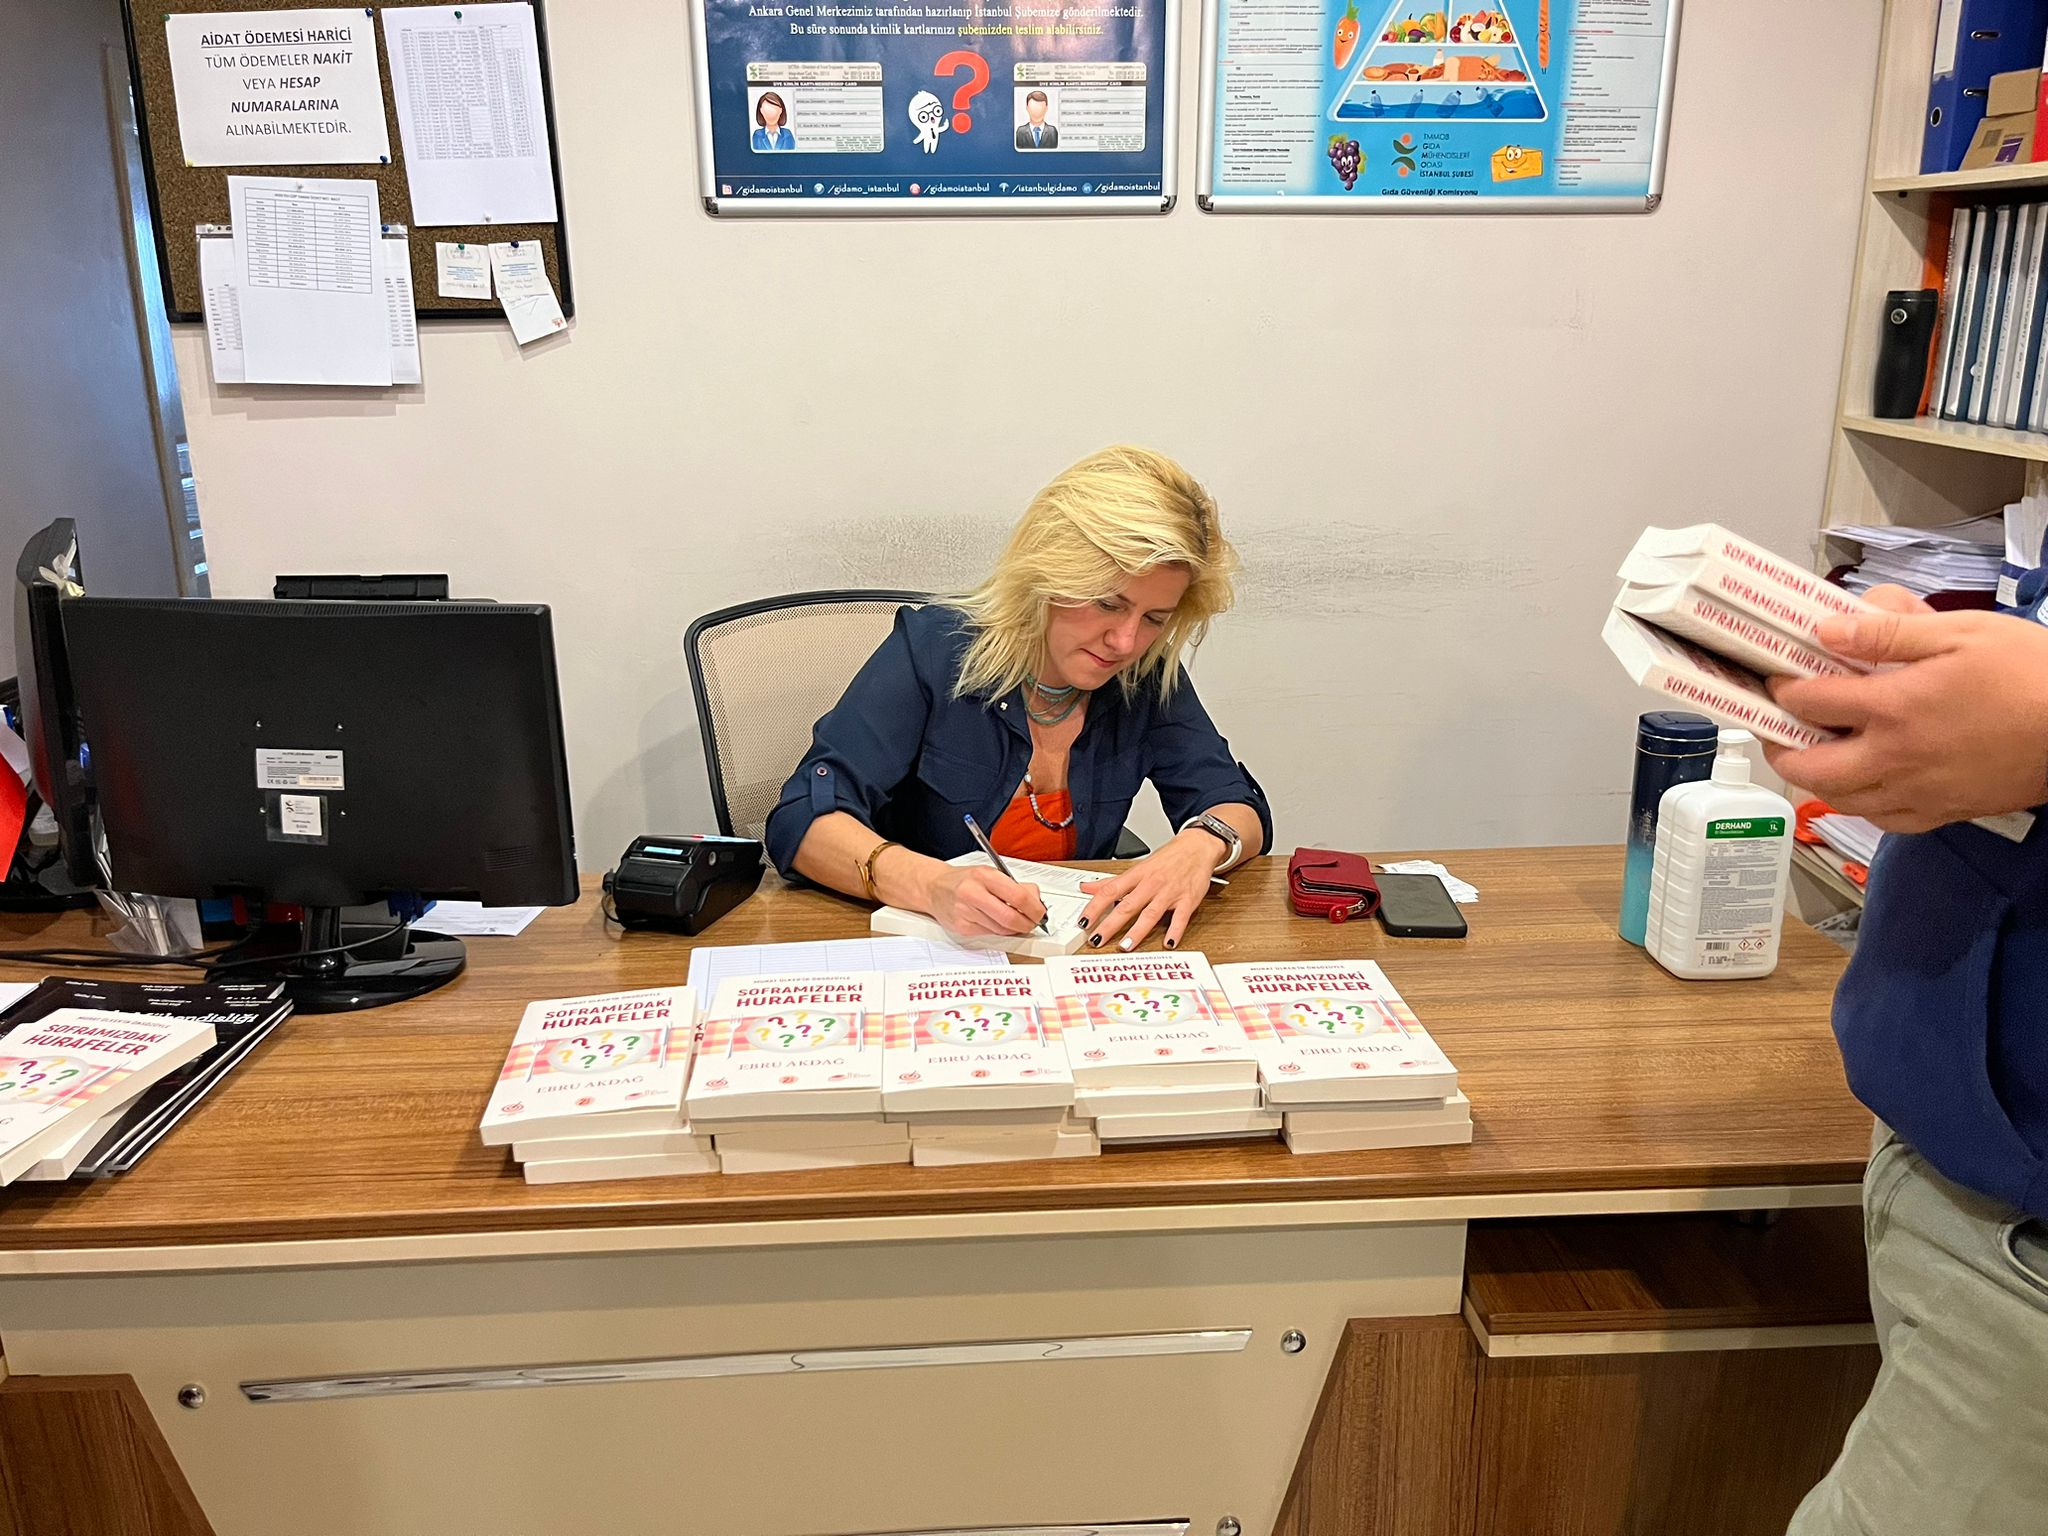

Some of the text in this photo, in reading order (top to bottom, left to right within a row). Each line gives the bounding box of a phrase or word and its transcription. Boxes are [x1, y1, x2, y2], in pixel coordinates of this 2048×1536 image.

[749, 5, 1143, 20] Ankara Genel Merkezimiz tarafından hazırlanıp İstanbul Şubemize gönderilmektedir.
[201, 26, 352, 46] AİDAT ÖDEMESİ HARİCİ
[790, 24, 1104, 37] Bu süre sonunda kimlik kartlarınızı şubemizden teslim alabilirsiniz.
[205, 50, 353, 68] TÜM ÖDEMELER NAKİT
[242, 76, 320, 90] VEYA HESAP
[231, 99, 340, 113] NUMARALARINA
[226, 120, 352, 136] ALINABİLMEKTEDİR.
[1722, 542, 1858, 614] SOFRAMIZDAKİ HURA
[1720, 575, 1812, 630] SOFRAMIZDAKİ
[1694, 601, 1842, 676] SOFRAMIZDAKİ HURAF
[1664, 676, 1760, 724] SOFRAMIZDAKİ
[1715, 822, 1752, 830] DERHAND
[1071, 961, 1190, 974] SOFRAMIZDAKİ
[908, 976, 1030, 990] SOFRAMIZDAKİ
[1074, 972, 1195, 984] HURAFELER
[1242, 971, 1366, 982] SOFRAMIZDAKİ
[738, 983, 863, 996] SOFRAMIZDAKİ
[910, 987, 1032, 1001] HURAFELER
[1248, 982, 1373, 993] HURAFELER
[736, 994, 862, 1007] HURAFELER
[545, 998, 673, 1019] SOFRAMIZDAKİ
[542, 1009, 670, 1030] HURAFELER
[43, 1024, 172, 1043] SOFRAMIZDAKİ
[1154, 1032, 1209, 1040] AKDAĞ
[22, 1034, 149, 1055] HURAFELER
[1300, 1045, 1403, 1056] EBRU AKDAĞ
[739, 1058, 845, 1070] EBRU AKDAĞ
[928, 1053, 1032, 1063] EBRU AKDAĞ
[537, 1076, 644, 1094] EBRU AKDAĞ
